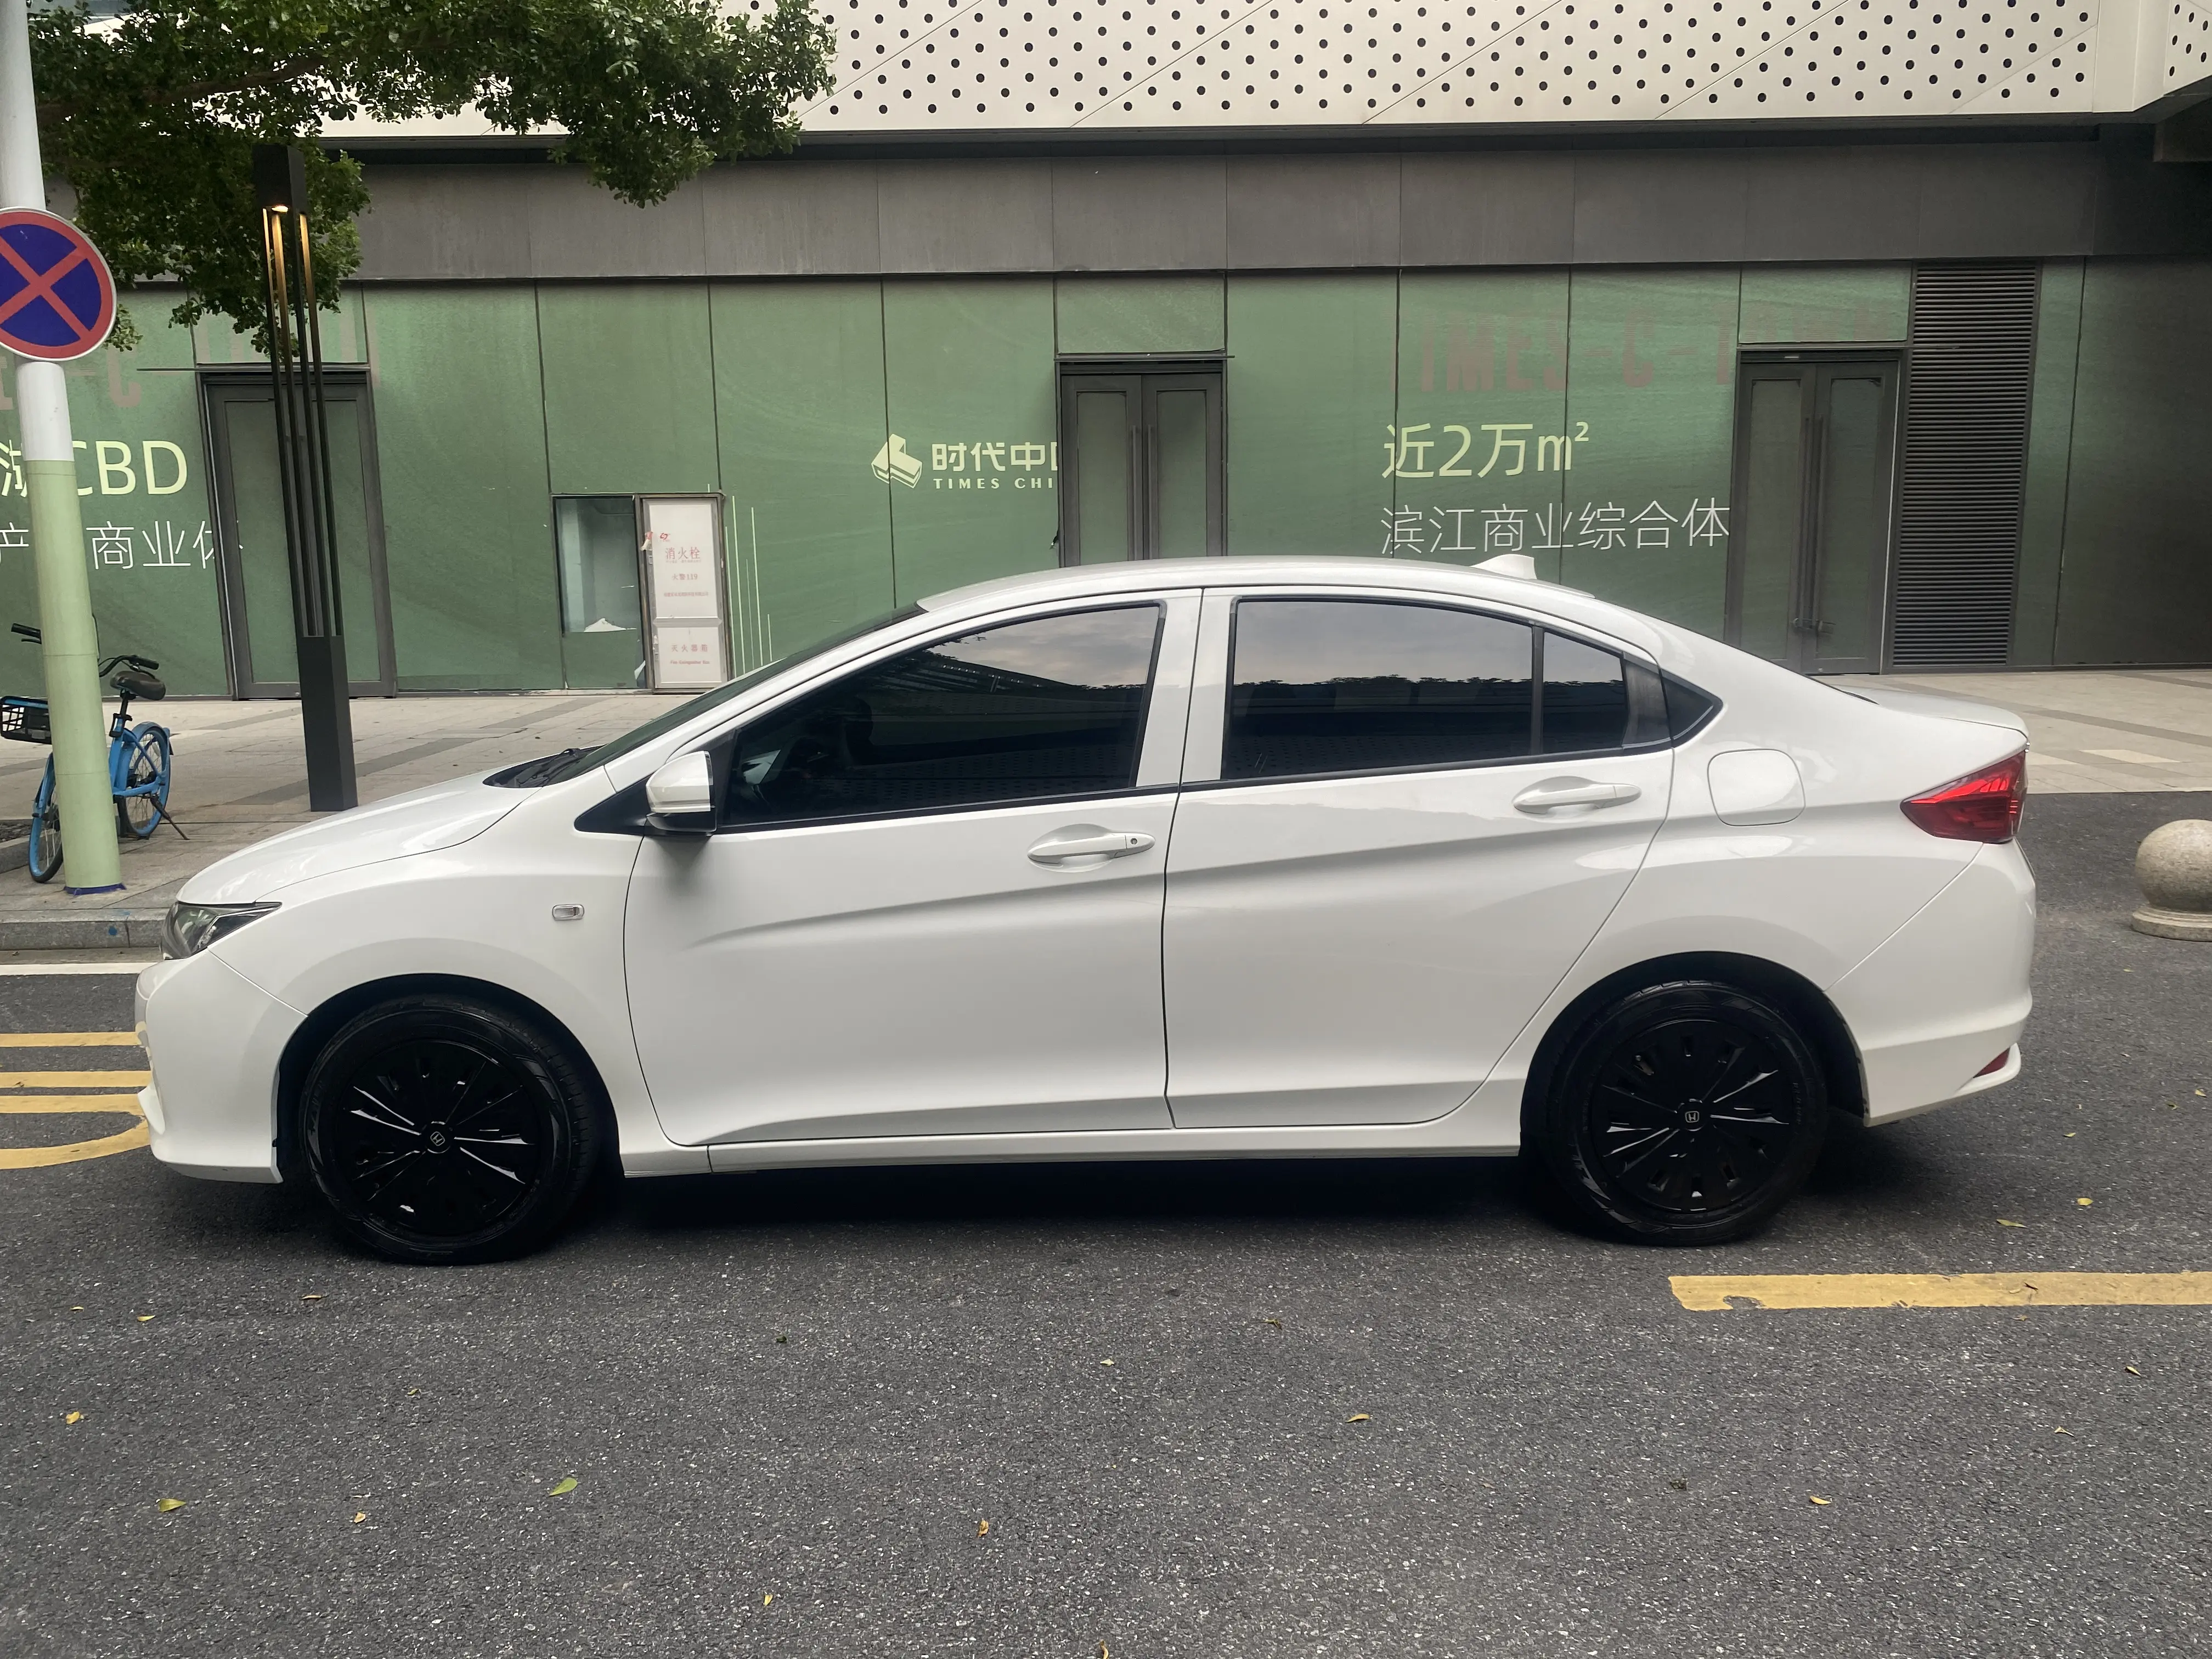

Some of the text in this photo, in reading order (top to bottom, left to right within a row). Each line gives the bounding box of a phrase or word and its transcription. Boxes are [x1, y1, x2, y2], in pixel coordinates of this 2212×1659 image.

[932, 442, 1058, 472] 时代中
[933, 478, 1000, 489] TIMES
[1381, 497, 1731, 555] 滨江商业综合体
[665, 546, 701, 560] 消火栓
